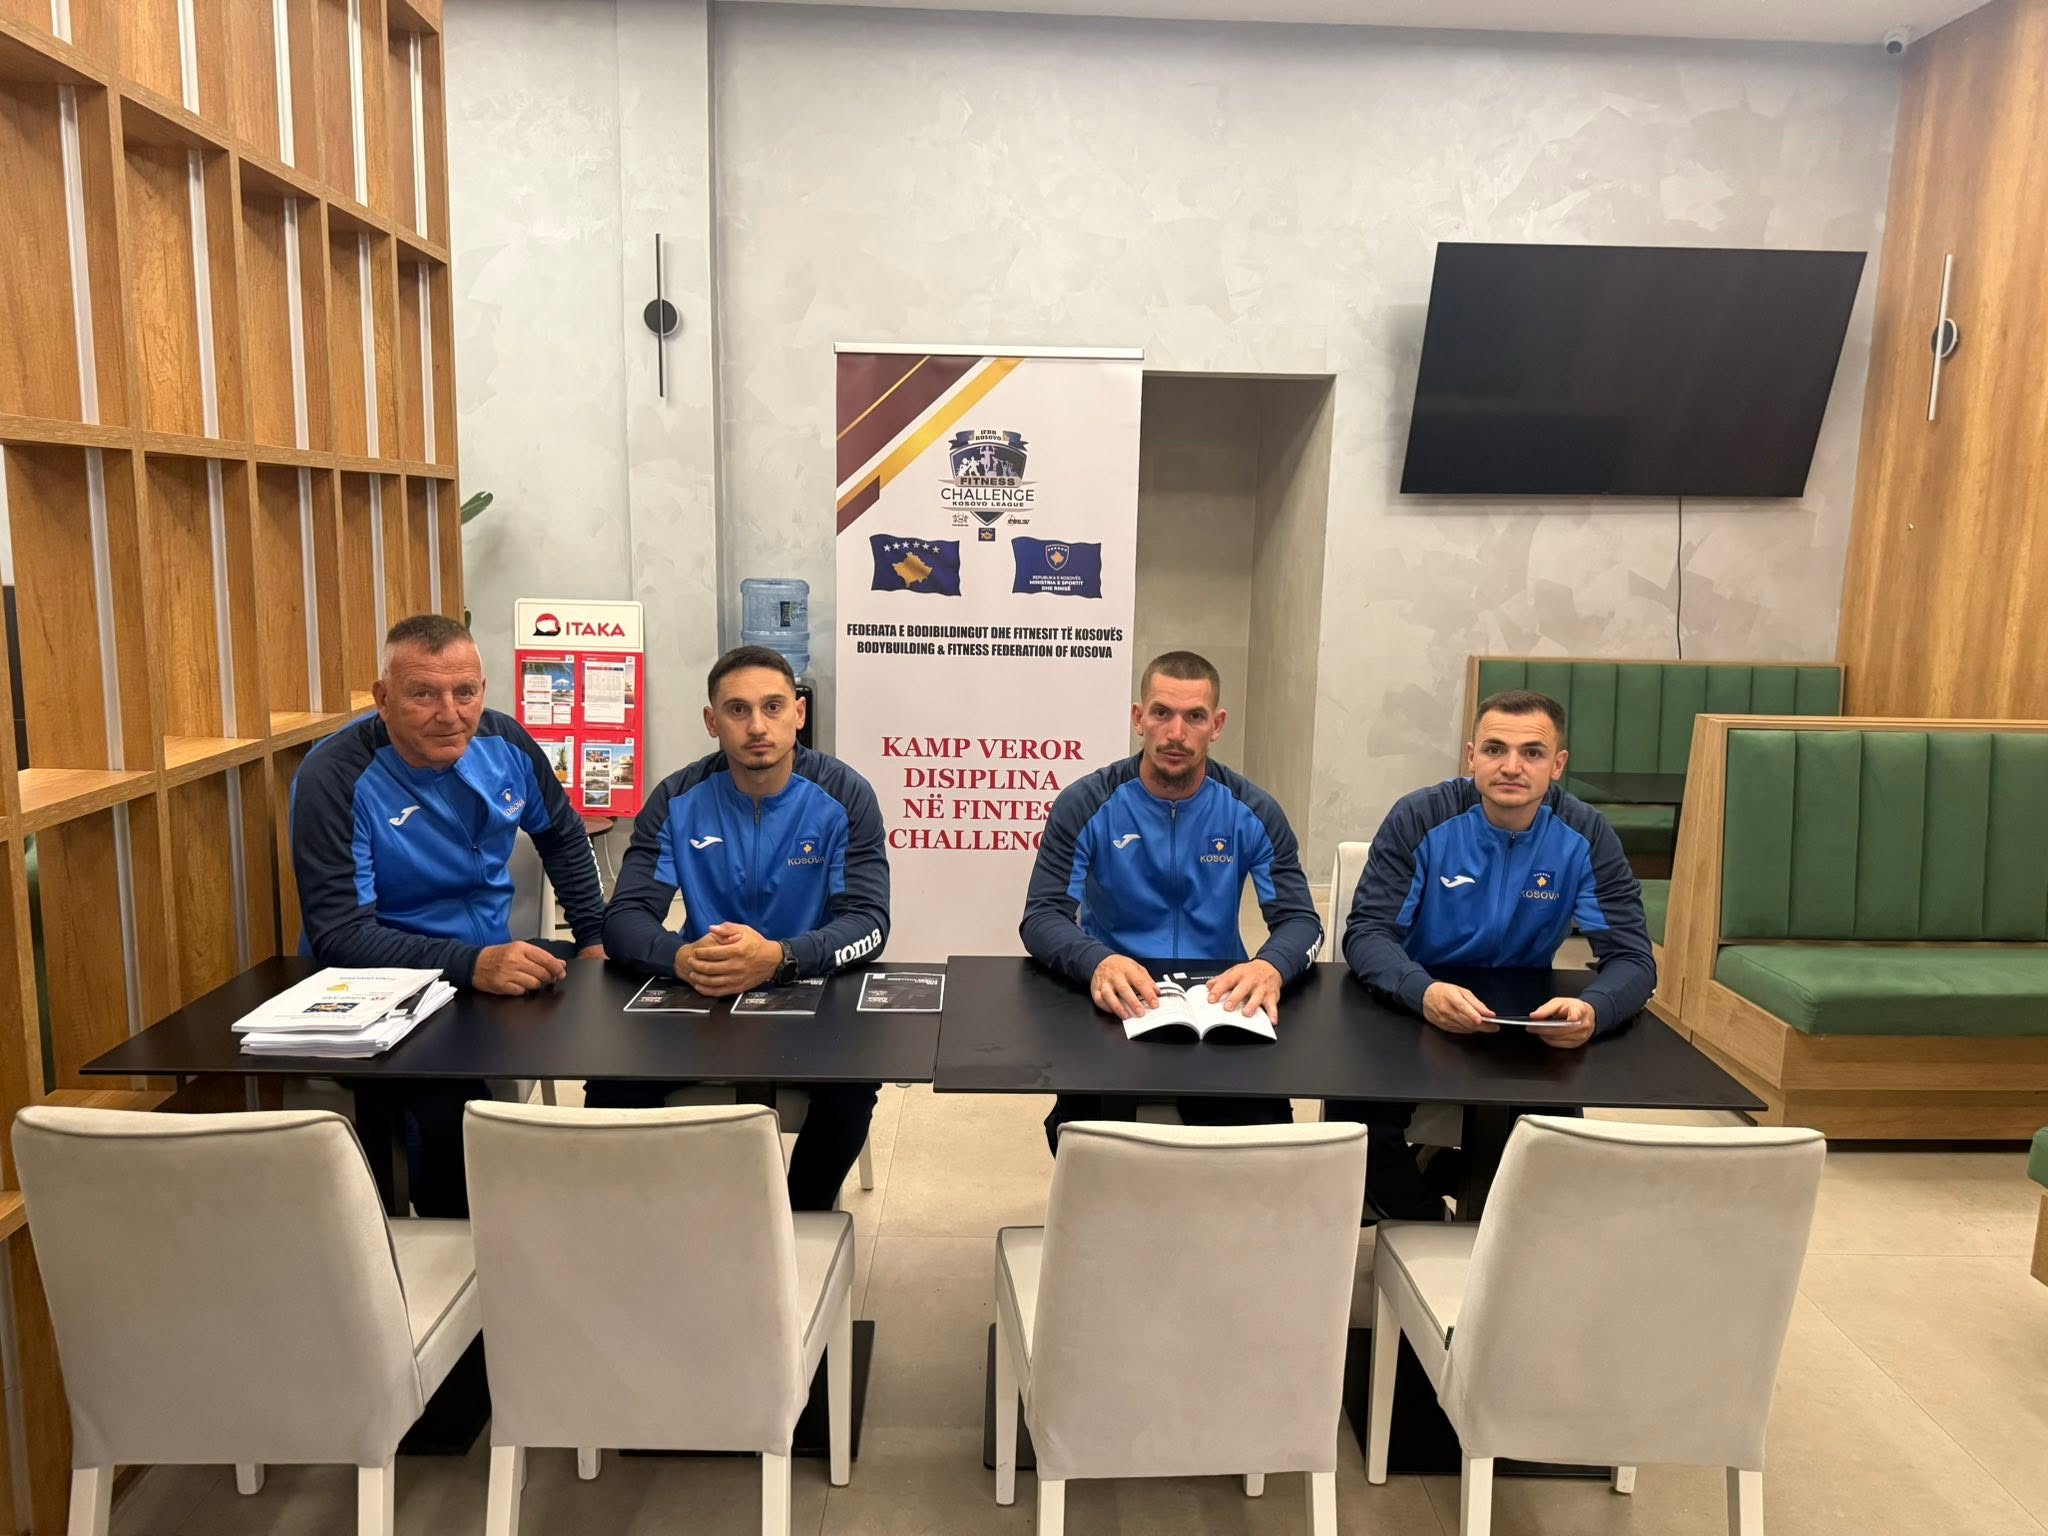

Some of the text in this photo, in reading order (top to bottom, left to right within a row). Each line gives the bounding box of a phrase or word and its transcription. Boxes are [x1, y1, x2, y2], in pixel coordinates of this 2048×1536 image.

[960, 477, 1016, 486] FITNESS
[941, 488, 1035, 502] CHALLENGE
[565, 621, 625, 637] ITAKA
[847, 623, 1123, 641] FEDERATA E BODIBILDINGUT DHE FITNESIT TË KOSOVËS
[857, 641, 1113, 658] BODYBUILDING & FITNESS FEDERATION OF KOSOVA
[881, 736, 1084, 760] KAMP VEROR
[903, 767, 1061, 790] DISIPLINA
[902, 793, 945, 819] NË
